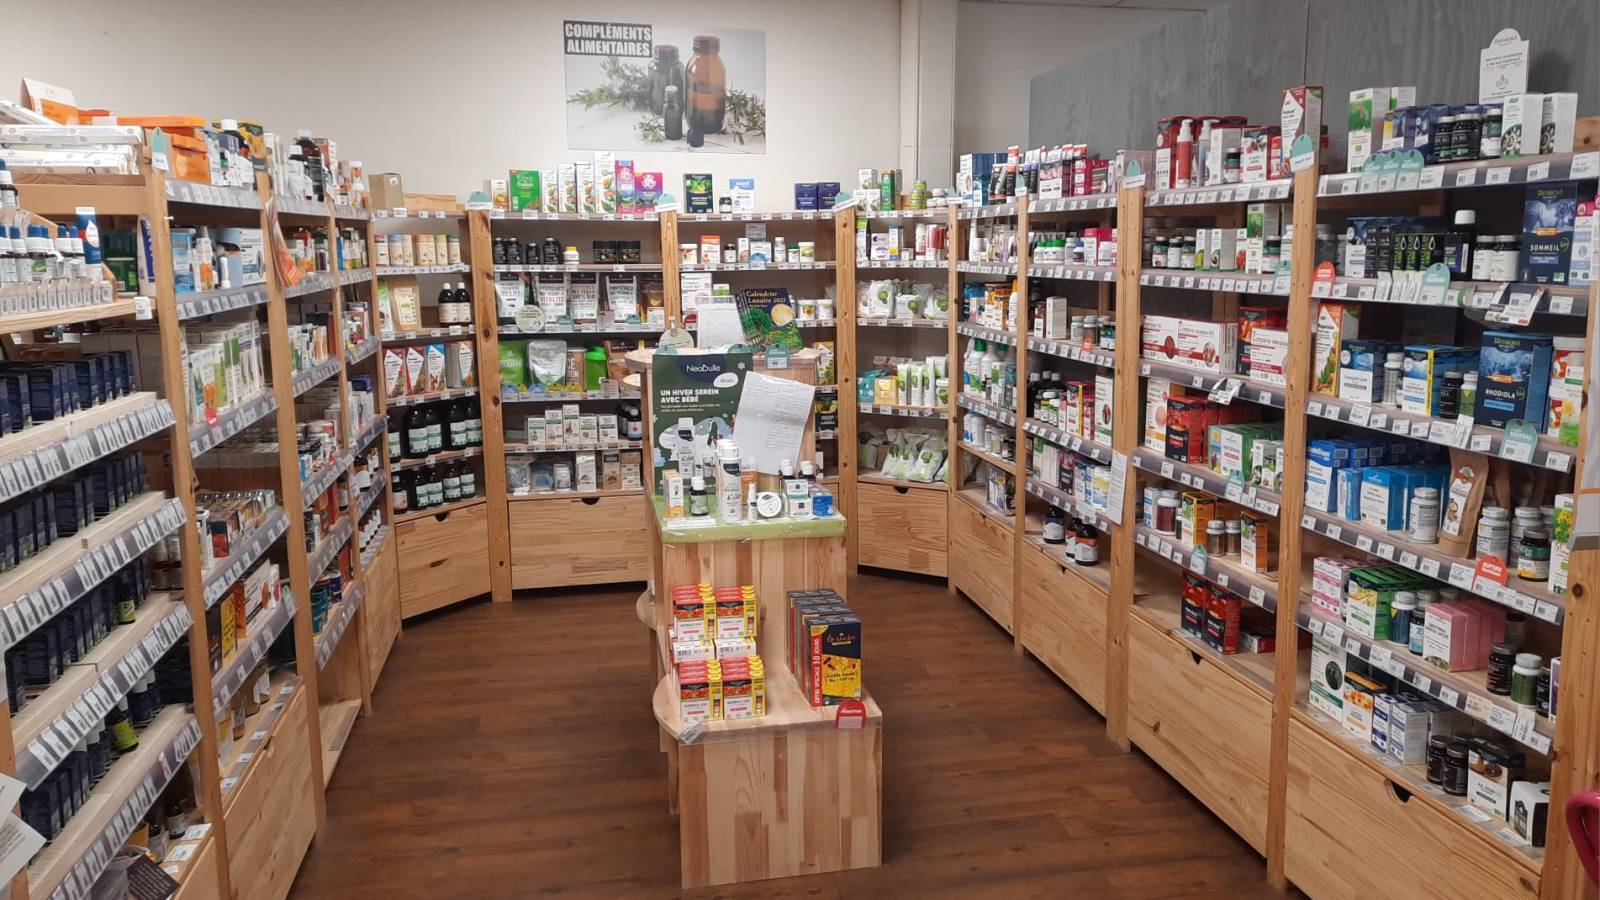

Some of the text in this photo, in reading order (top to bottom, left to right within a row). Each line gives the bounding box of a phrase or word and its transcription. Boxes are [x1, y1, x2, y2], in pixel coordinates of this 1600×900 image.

[565, 22, 652, 41] COMPLÉMENTS
[567, 39, 650, 57] ALIMENTAIRES
[694, 388, 720, 396] SEREIN
[1485, 388, 1516, 399] RHODIOLA
[681, 395, 699, 403] BÉBÉ
